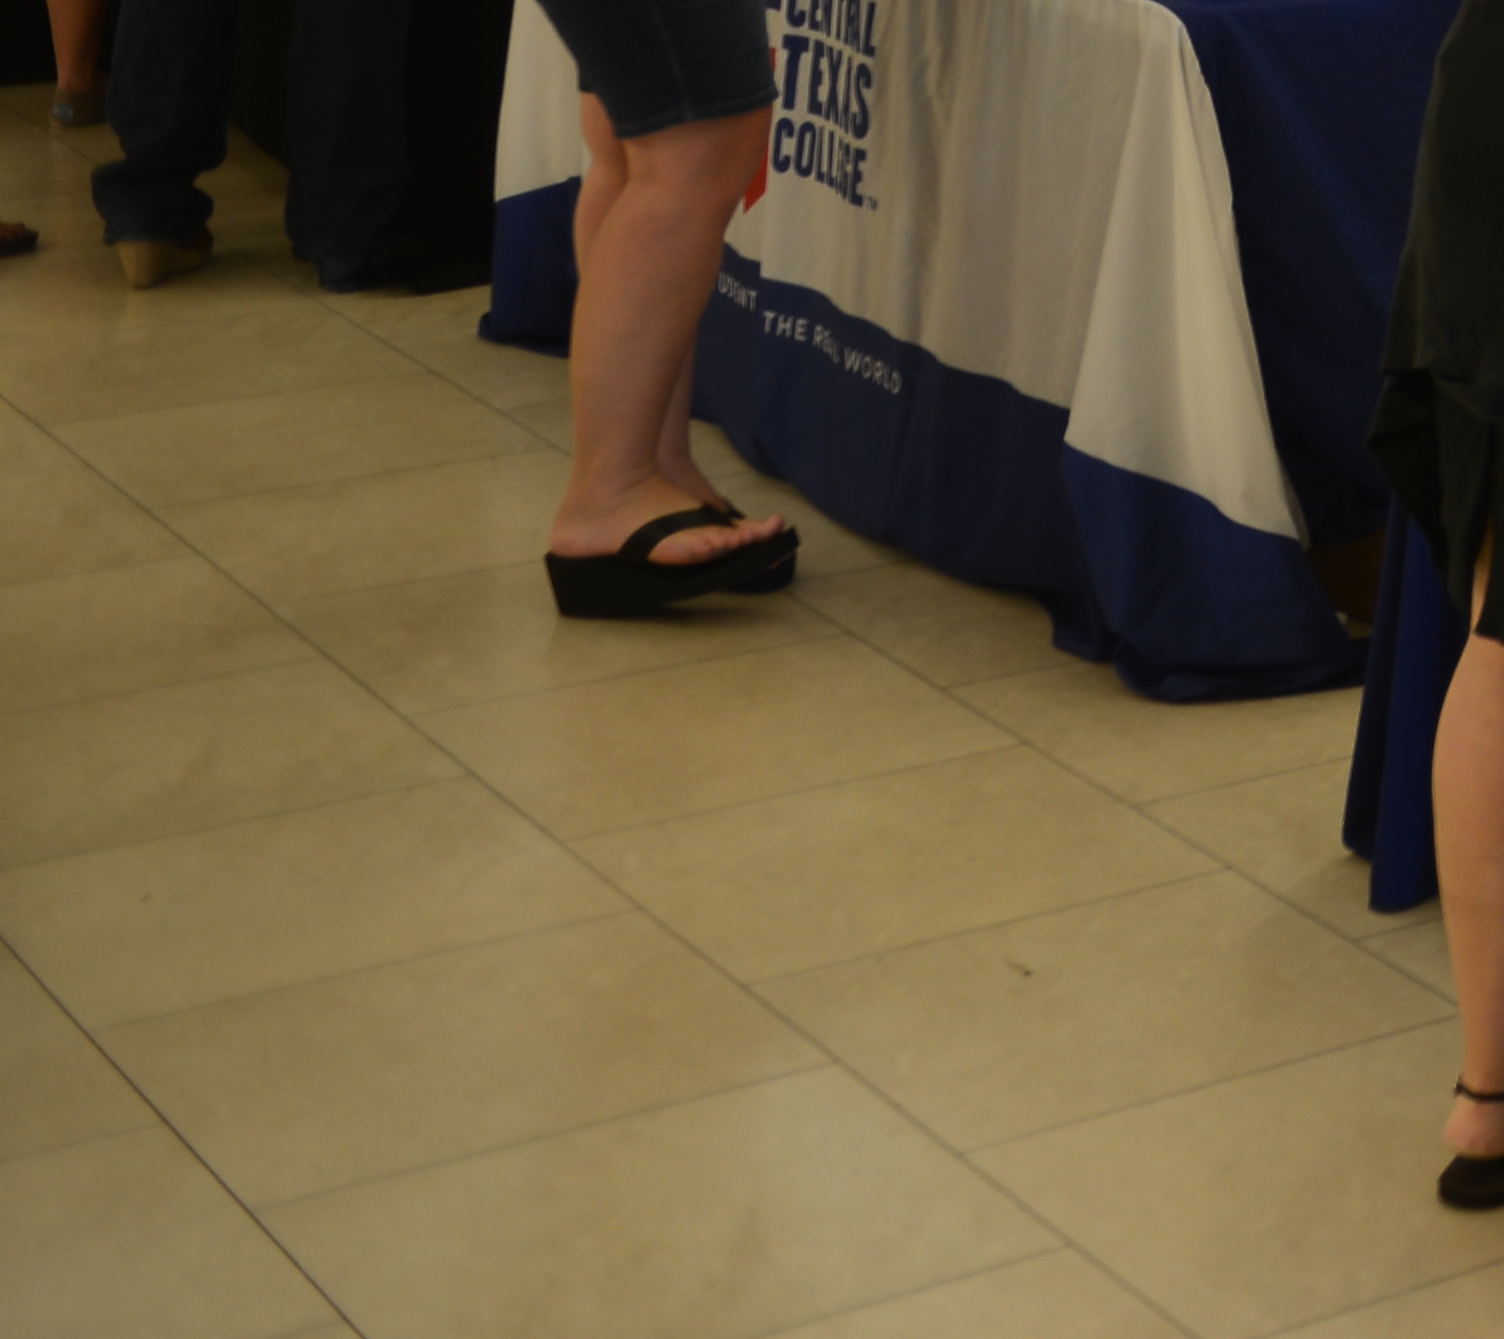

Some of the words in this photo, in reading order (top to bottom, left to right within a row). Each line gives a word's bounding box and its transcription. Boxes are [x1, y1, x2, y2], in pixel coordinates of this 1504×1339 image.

[781, 33, 873, 141] TEXAS
[763, 310, 810, 342] THE
[844, 348, 902, 395] WORLD
